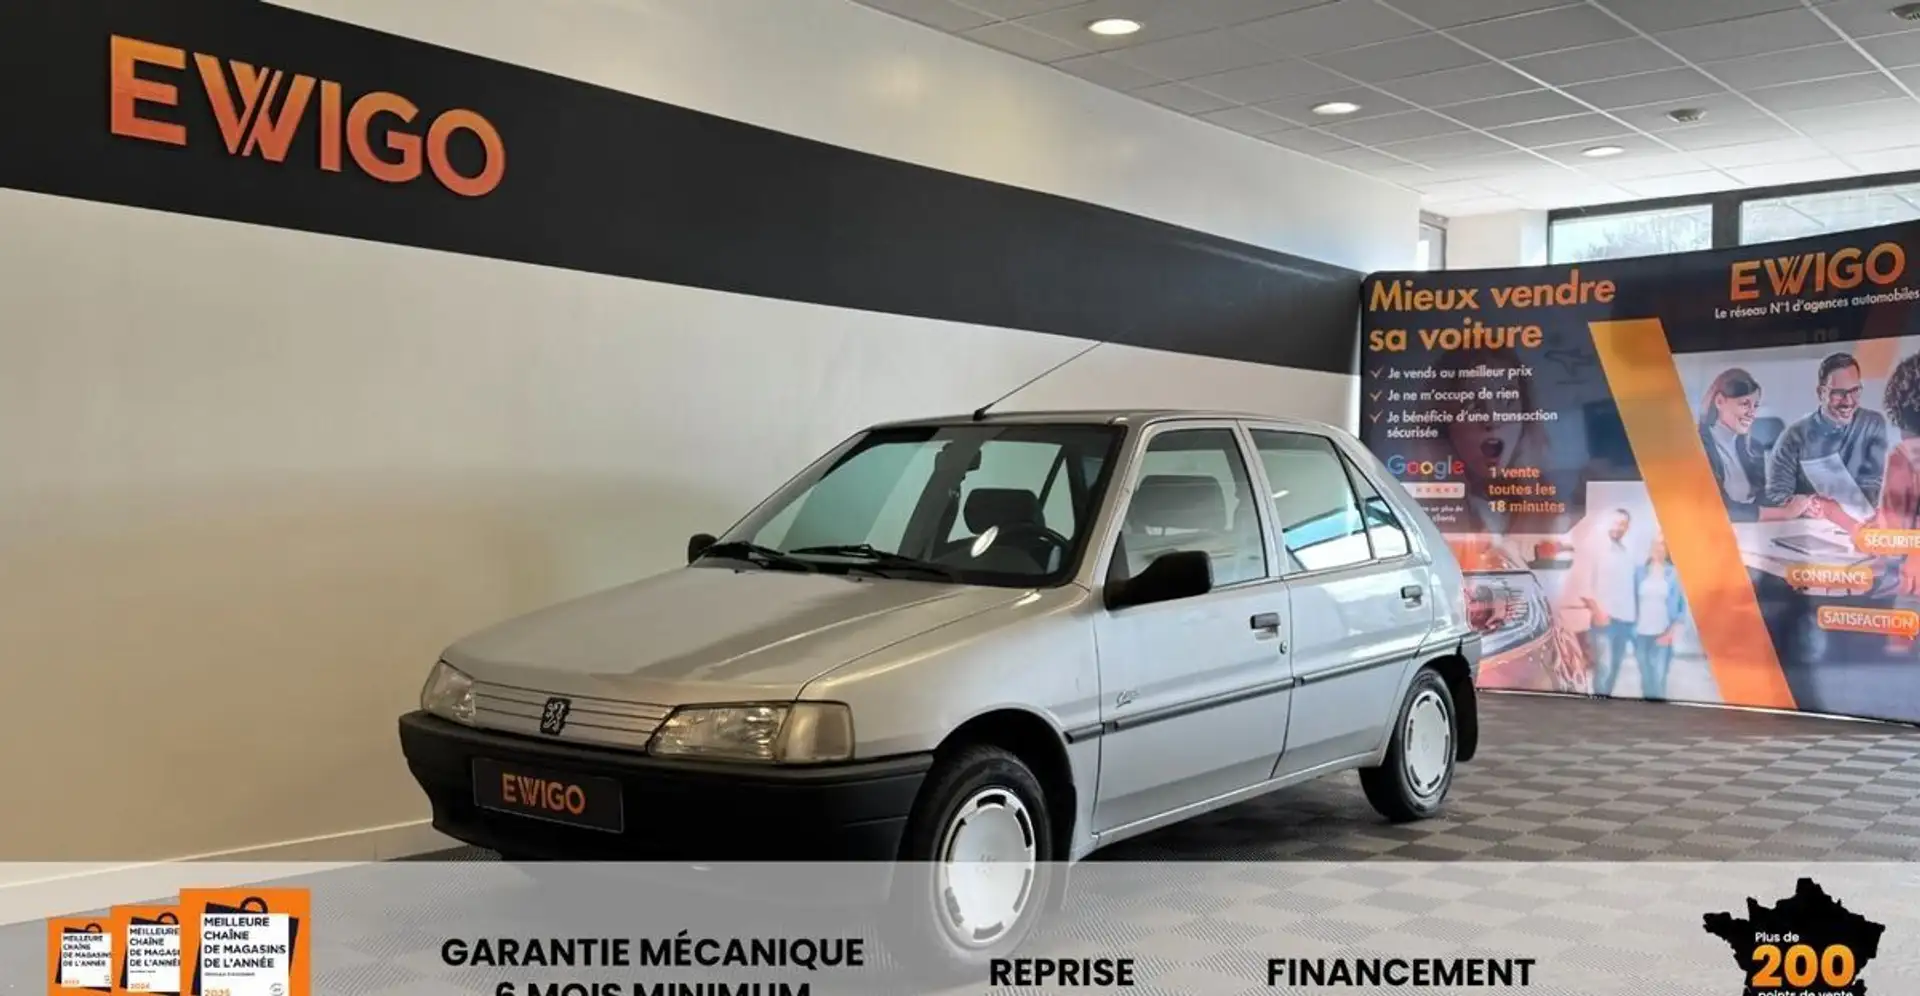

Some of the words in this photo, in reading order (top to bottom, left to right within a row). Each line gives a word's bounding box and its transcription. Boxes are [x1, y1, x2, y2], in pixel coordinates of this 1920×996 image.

[111, 34, 506, 197] EWIGO
[1730, 241, 1906, 301] EWIGO
[1369, 279, 1480, 312] Mieux
[1490, 269, 1616, 309] vendre
[1714, 307, 1727, 319] Le
[1730, 305, 1767, 318] réseau
[1792, 298, 1849, 313] d'agences
[1852, 287, 1920, 306] automobiles
[1369, 328, 1408, 351] sa
[1418, 317, 1543, 350] voiture
[1388, 367, 1400, 379] Je
[1403, 366, 1437, 379] vends
[1440, 369, 1456, 378] au
[1458, 365, 1505, 378] meilleur
[1507, 364, 1534, 380] prix
[1388, 389, 1400, 401] Je
[1403, 391, 1418, 401] ne
[1420, 388, 1475, 403] m'occupe
[1478, 387, 1493, 399] de
[1496, 387, 1520, 399] rien
[1387, 410, 1400, 423] Je
[1402, 409, 1454, 422] bénéficie
[1456, 409, 1490, 422] d'une
[1493, 409, 1559, 422] transaction
[1387, 426, 1438, 438] sécurisée
[1388, 454, 1465, 480] Google
[1488, 466, 1497, 479] 1
[1501, 466, 1540, 479] vente
[1488, 484, 1532, 495] toutes
[1536, 482, 1557, 495] les
[1488, 500, 1506, 513] 18
[1510, 500, 1566, 513] minutes
[1792, 569, 1868, 585] CONFIANCE
[1823, 610, 1914, 630] SATISFACTION
[502, 772, 586, 815] EWIGO
